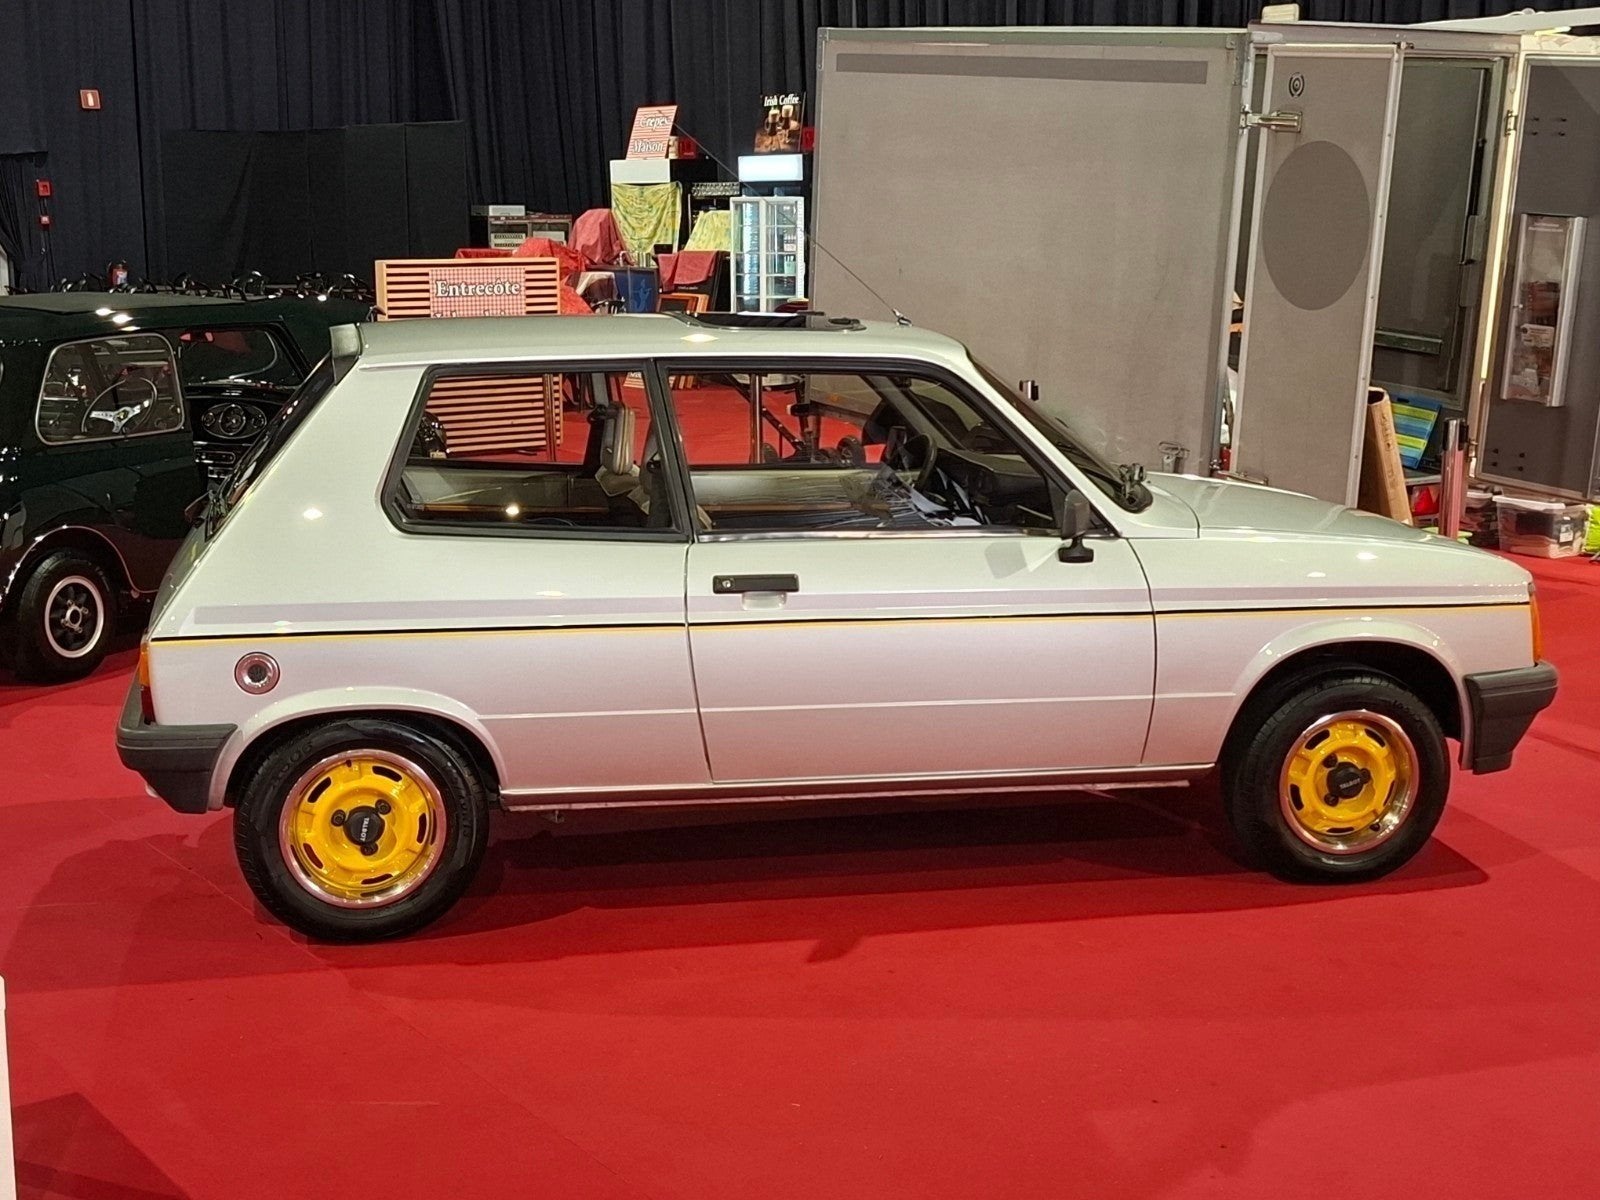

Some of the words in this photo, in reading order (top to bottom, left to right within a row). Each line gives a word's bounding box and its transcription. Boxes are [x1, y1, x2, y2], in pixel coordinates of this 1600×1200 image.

[764, 95, 778, 107] Irish
[779, 93, 799, 105] Coffee
[633, 138, 665, 153] Maison
[435, 278, 520, 297] Entrecôte
[360, 817, 370, 842] TALBOT
